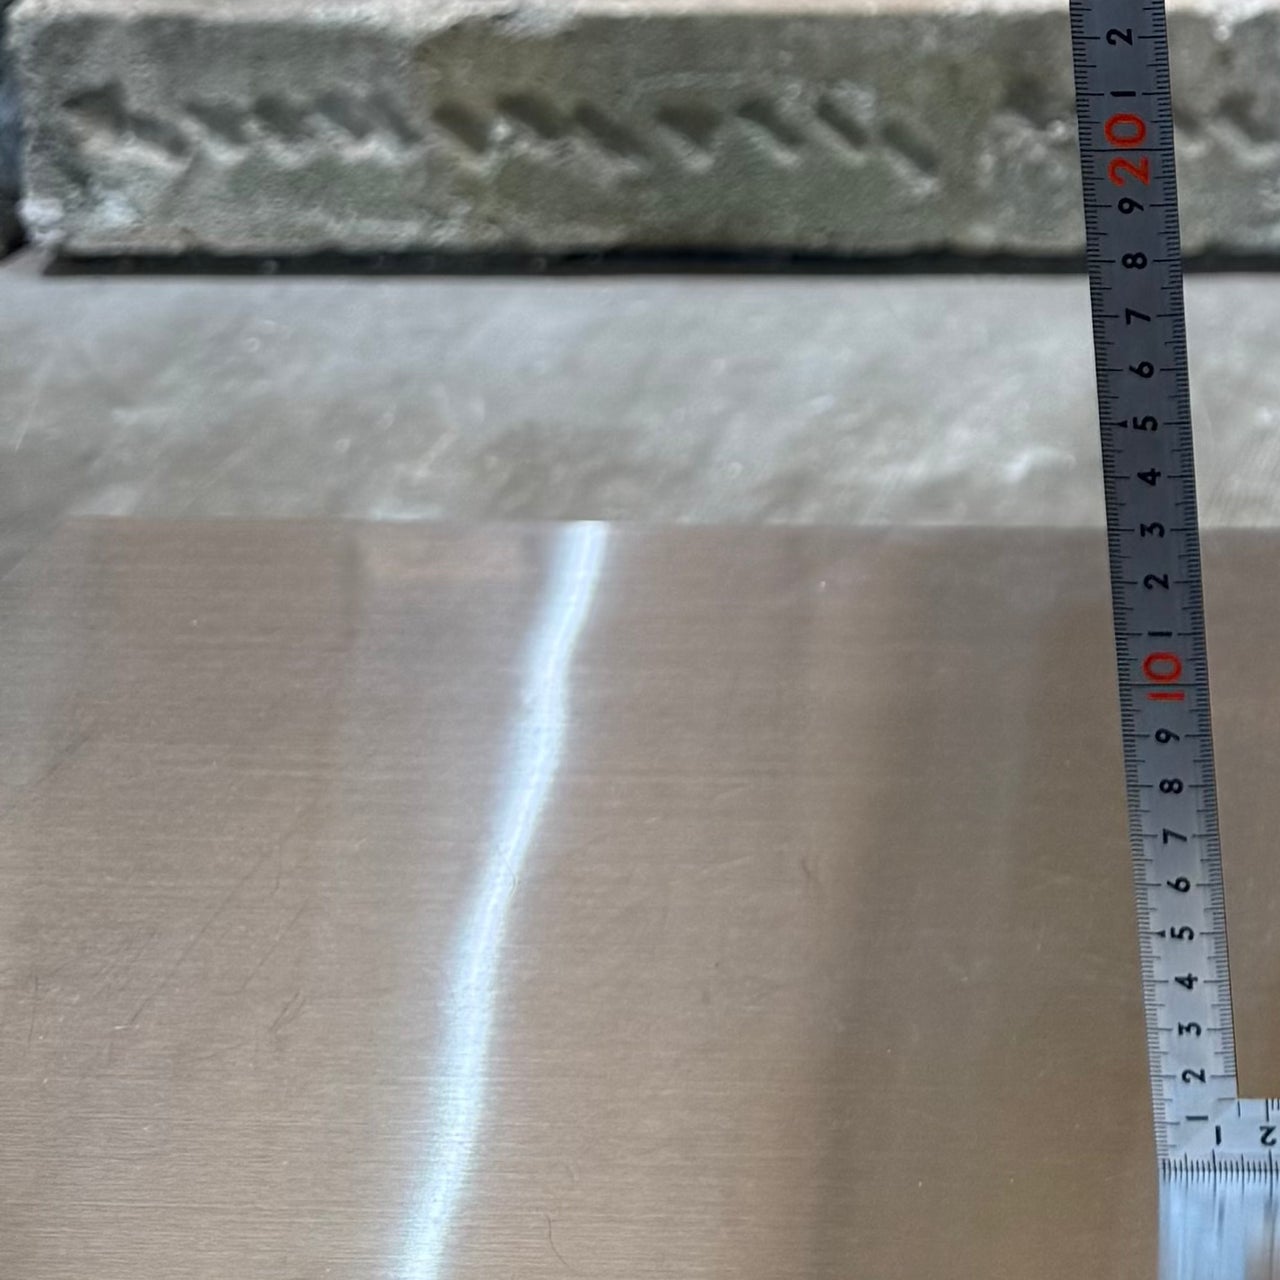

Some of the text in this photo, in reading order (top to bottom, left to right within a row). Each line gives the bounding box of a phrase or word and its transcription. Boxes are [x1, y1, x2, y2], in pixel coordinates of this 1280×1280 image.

[1106, 27, 1132, 46] 2
[1118, 197, 1144, 214] 9
[1121, 252, 1147, 269] 8
[1125, 308, 1151, 325] 7
[1129, 360, 1154, 378] 6
[1133, 416, 1158, 431] 5
[1137, 468, 1162, 486] 4
[1141, 522, 1166, 538] 3
[1144, 574, 1169, 590] 2
[1155, 728, 1180, 744] 9
[1159, 778, 1184, 794] 8
[1162, 828, 1188, 843] 7
[1166, 877, 1191, 892] 6
[1171, 926, 1194, 940] 5
[1174, 973, 1198, 991] 4
[1178, 1021, 1201, 1037] 3
[1182, 1069, 1206, 1084] 2
[1259, 1127, 1277, 1146] 2
